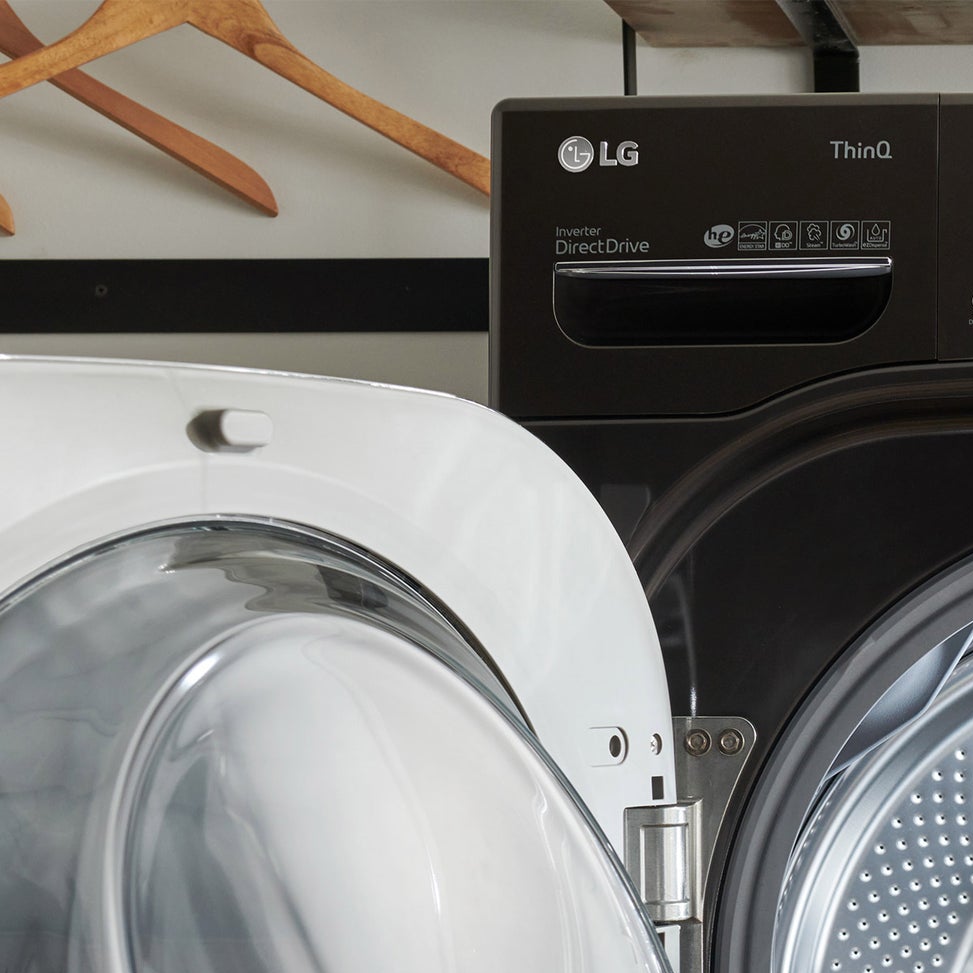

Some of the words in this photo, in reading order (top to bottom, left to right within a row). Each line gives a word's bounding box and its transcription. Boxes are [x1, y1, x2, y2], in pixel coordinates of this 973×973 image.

[600, 141, 639, 166] LG
[830, 141, 892, 159] ThinQ
[556, 226, 601, 237] Inverter
